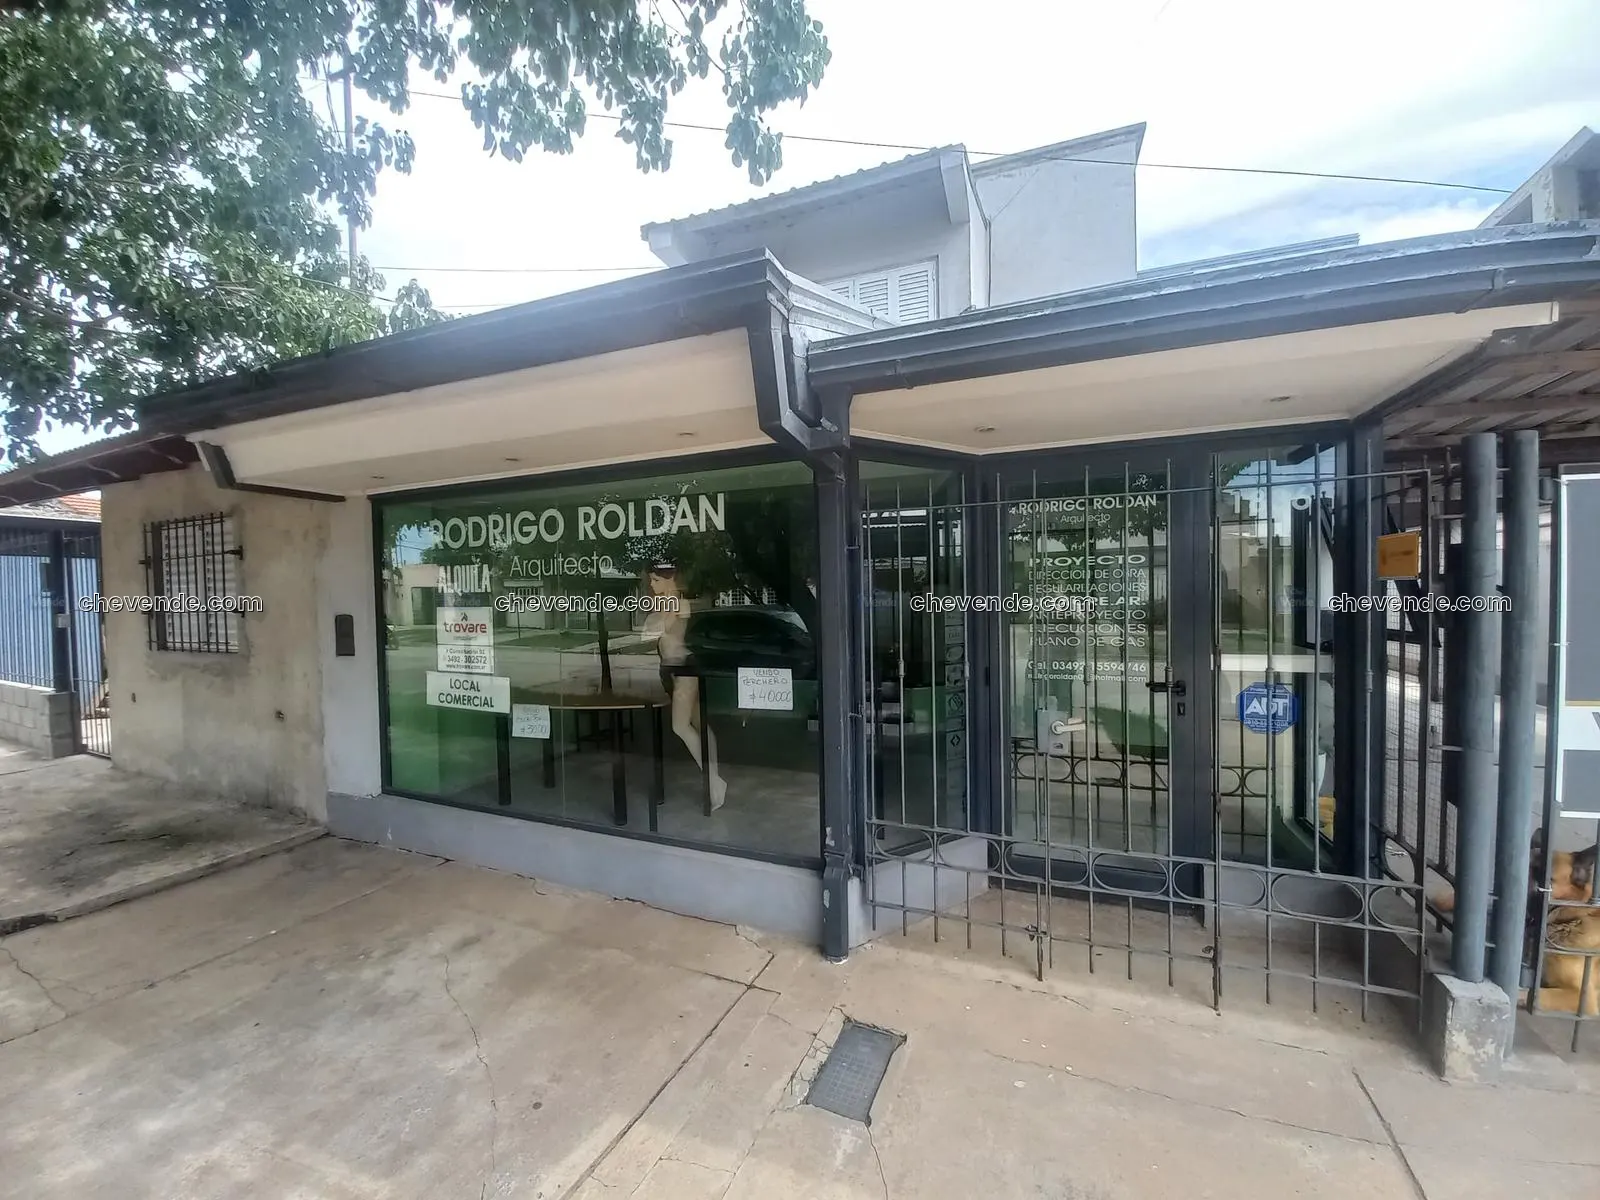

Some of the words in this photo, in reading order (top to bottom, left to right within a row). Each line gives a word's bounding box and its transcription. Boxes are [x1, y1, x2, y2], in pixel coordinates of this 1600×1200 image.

[429, 508, 565, 550] RODRIGO
[577, 485, 726, 541] ROLDÁN
[509, 552, 613, 581] Arquitecto
[1029, 554, 1146, 567] PROYECTO
[437, 563, 492, 595] ALQUILA
[1094, 569, 1109, 579] DE
[1028, 610, 1147, 621] ANTEPROYECTO
[443, 622, 487, 633] trovare
[1029, 624, 1147, 634] EJECUCIONES
[1029, 636, 1081, 647] PLANO
[1087, 637, 1105, 647] DE
[1110, 636, 1146, 647] GAS
[449, 678, 481, 692] LOCAL
[438, 693, 494, 708] COMERCIAL
[1246, 697, 1289, 716] ADT
